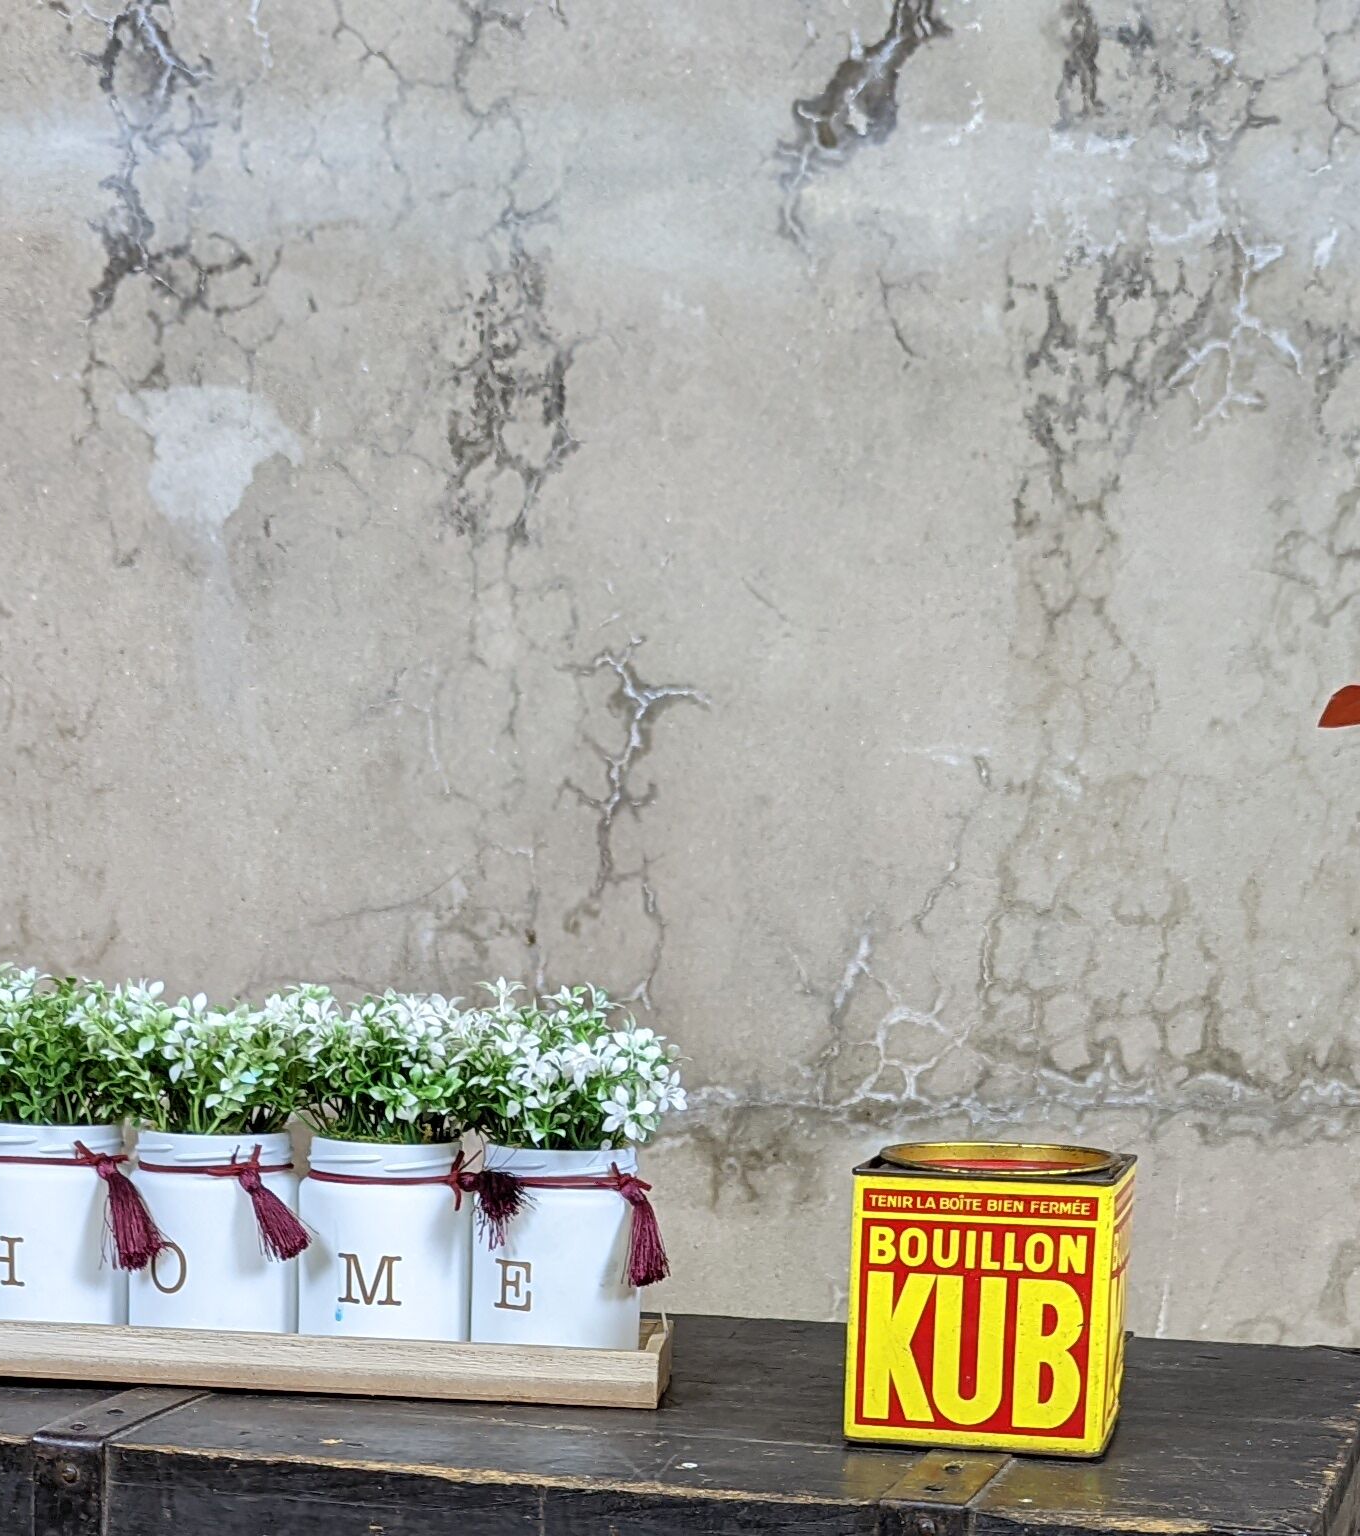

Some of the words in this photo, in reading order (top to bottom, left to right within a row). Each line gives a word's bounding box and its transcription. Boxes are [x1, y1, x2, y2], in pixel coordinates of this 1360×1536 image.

[869, 1193, 914, 1210] TENIR
[916, 1195, 937, 1210] LA
[939, 1194, 982, 1212] BOÎTE
[986, 1198, 1024, 1213] BIEN
[1029, 1199, 1091, 1216] FERMÉE
[868, 1225, 1088, 1275] BOUILLON
[862, 1270, 1084, 1430] KUB
